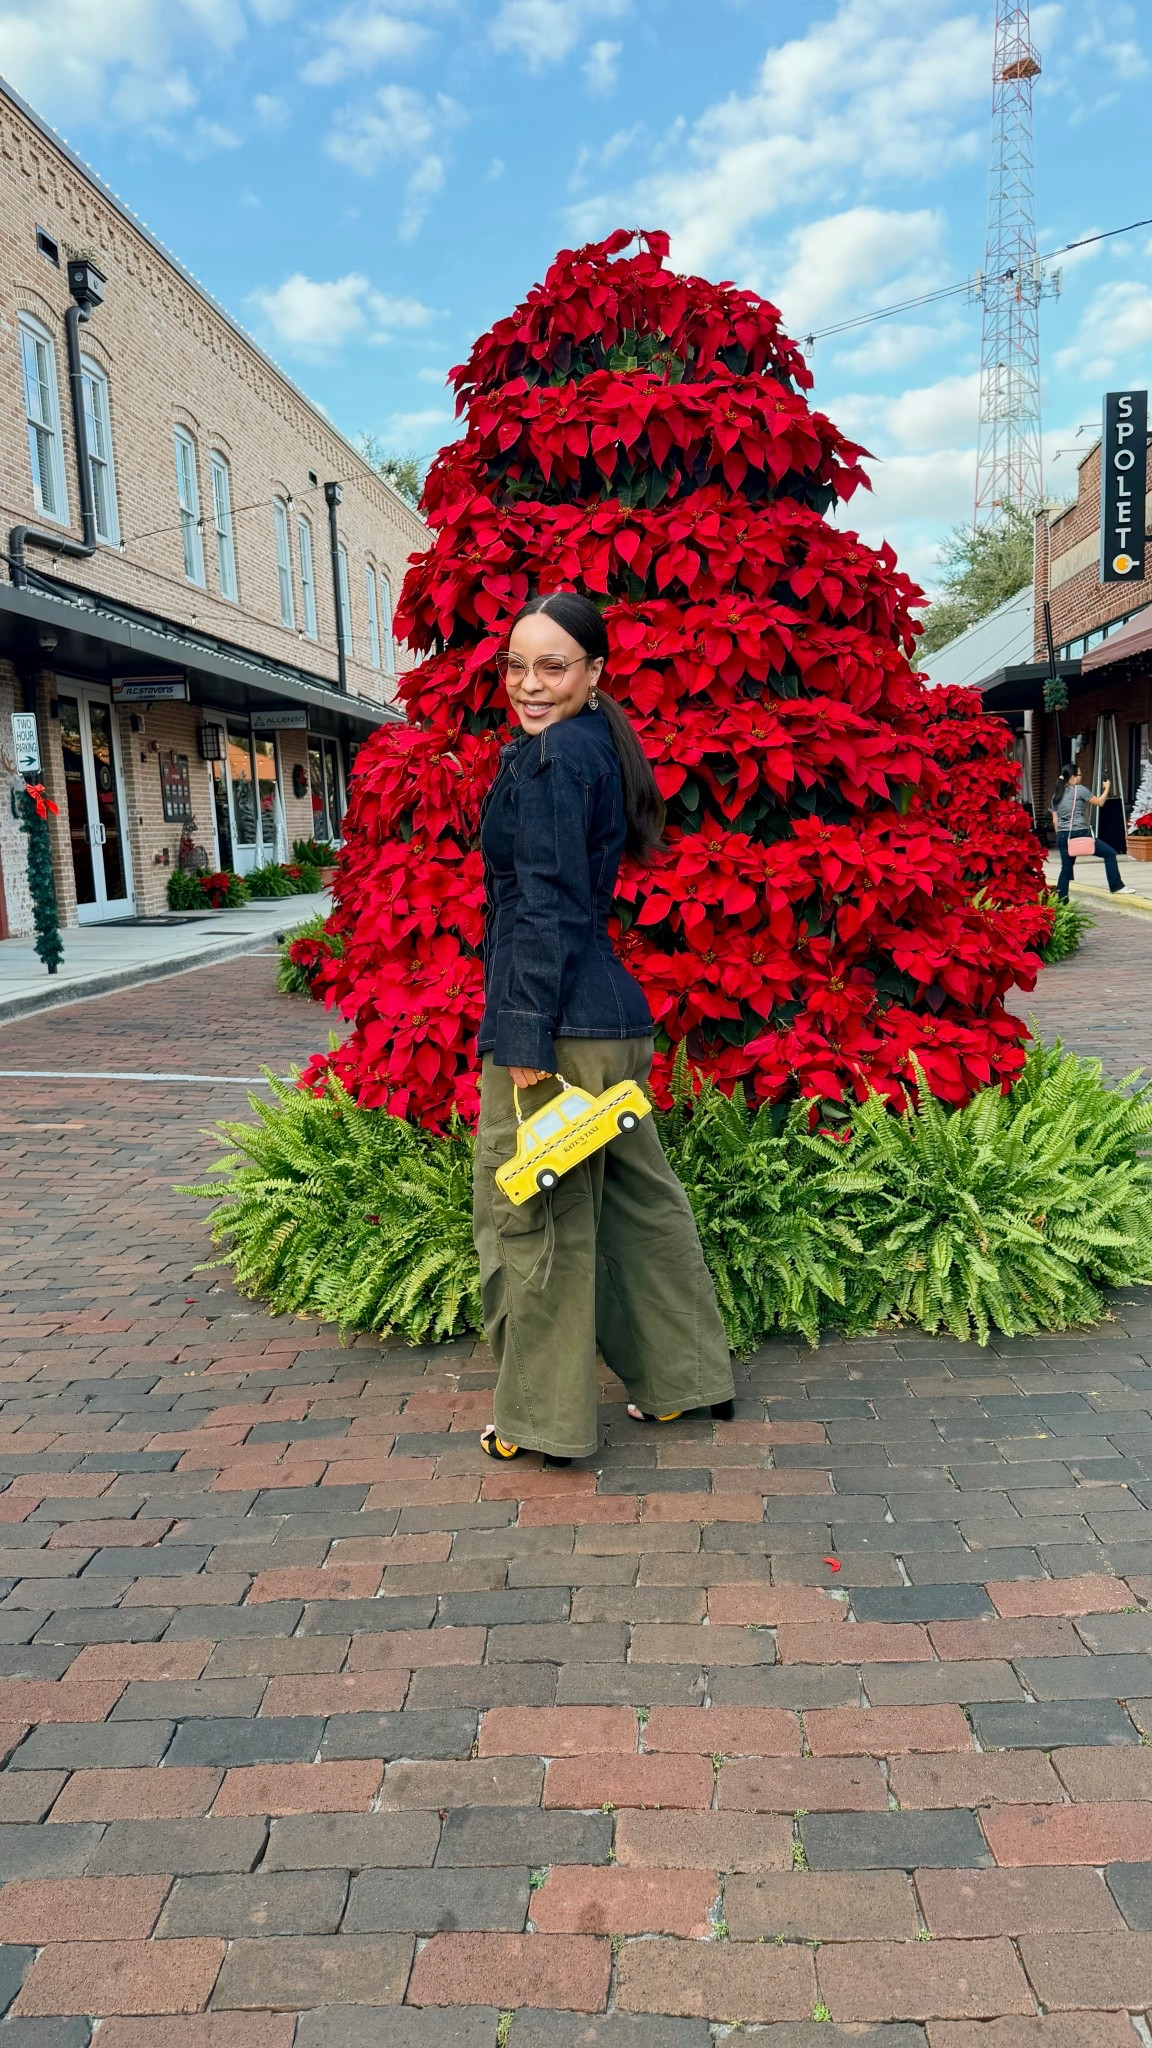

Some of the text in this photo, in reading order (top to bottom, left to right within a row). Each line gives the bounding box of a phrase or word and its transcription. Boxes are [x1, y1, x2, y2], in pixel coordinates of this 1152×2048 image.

[17, 719, 31, 729] TWO
[17, 730, 34, 741] HOUR
[16, 743, 37, 753] PARKING
[563, 1136, 585, 1152] KATE'S
[584, 1126, 598, 1137] TAXI
